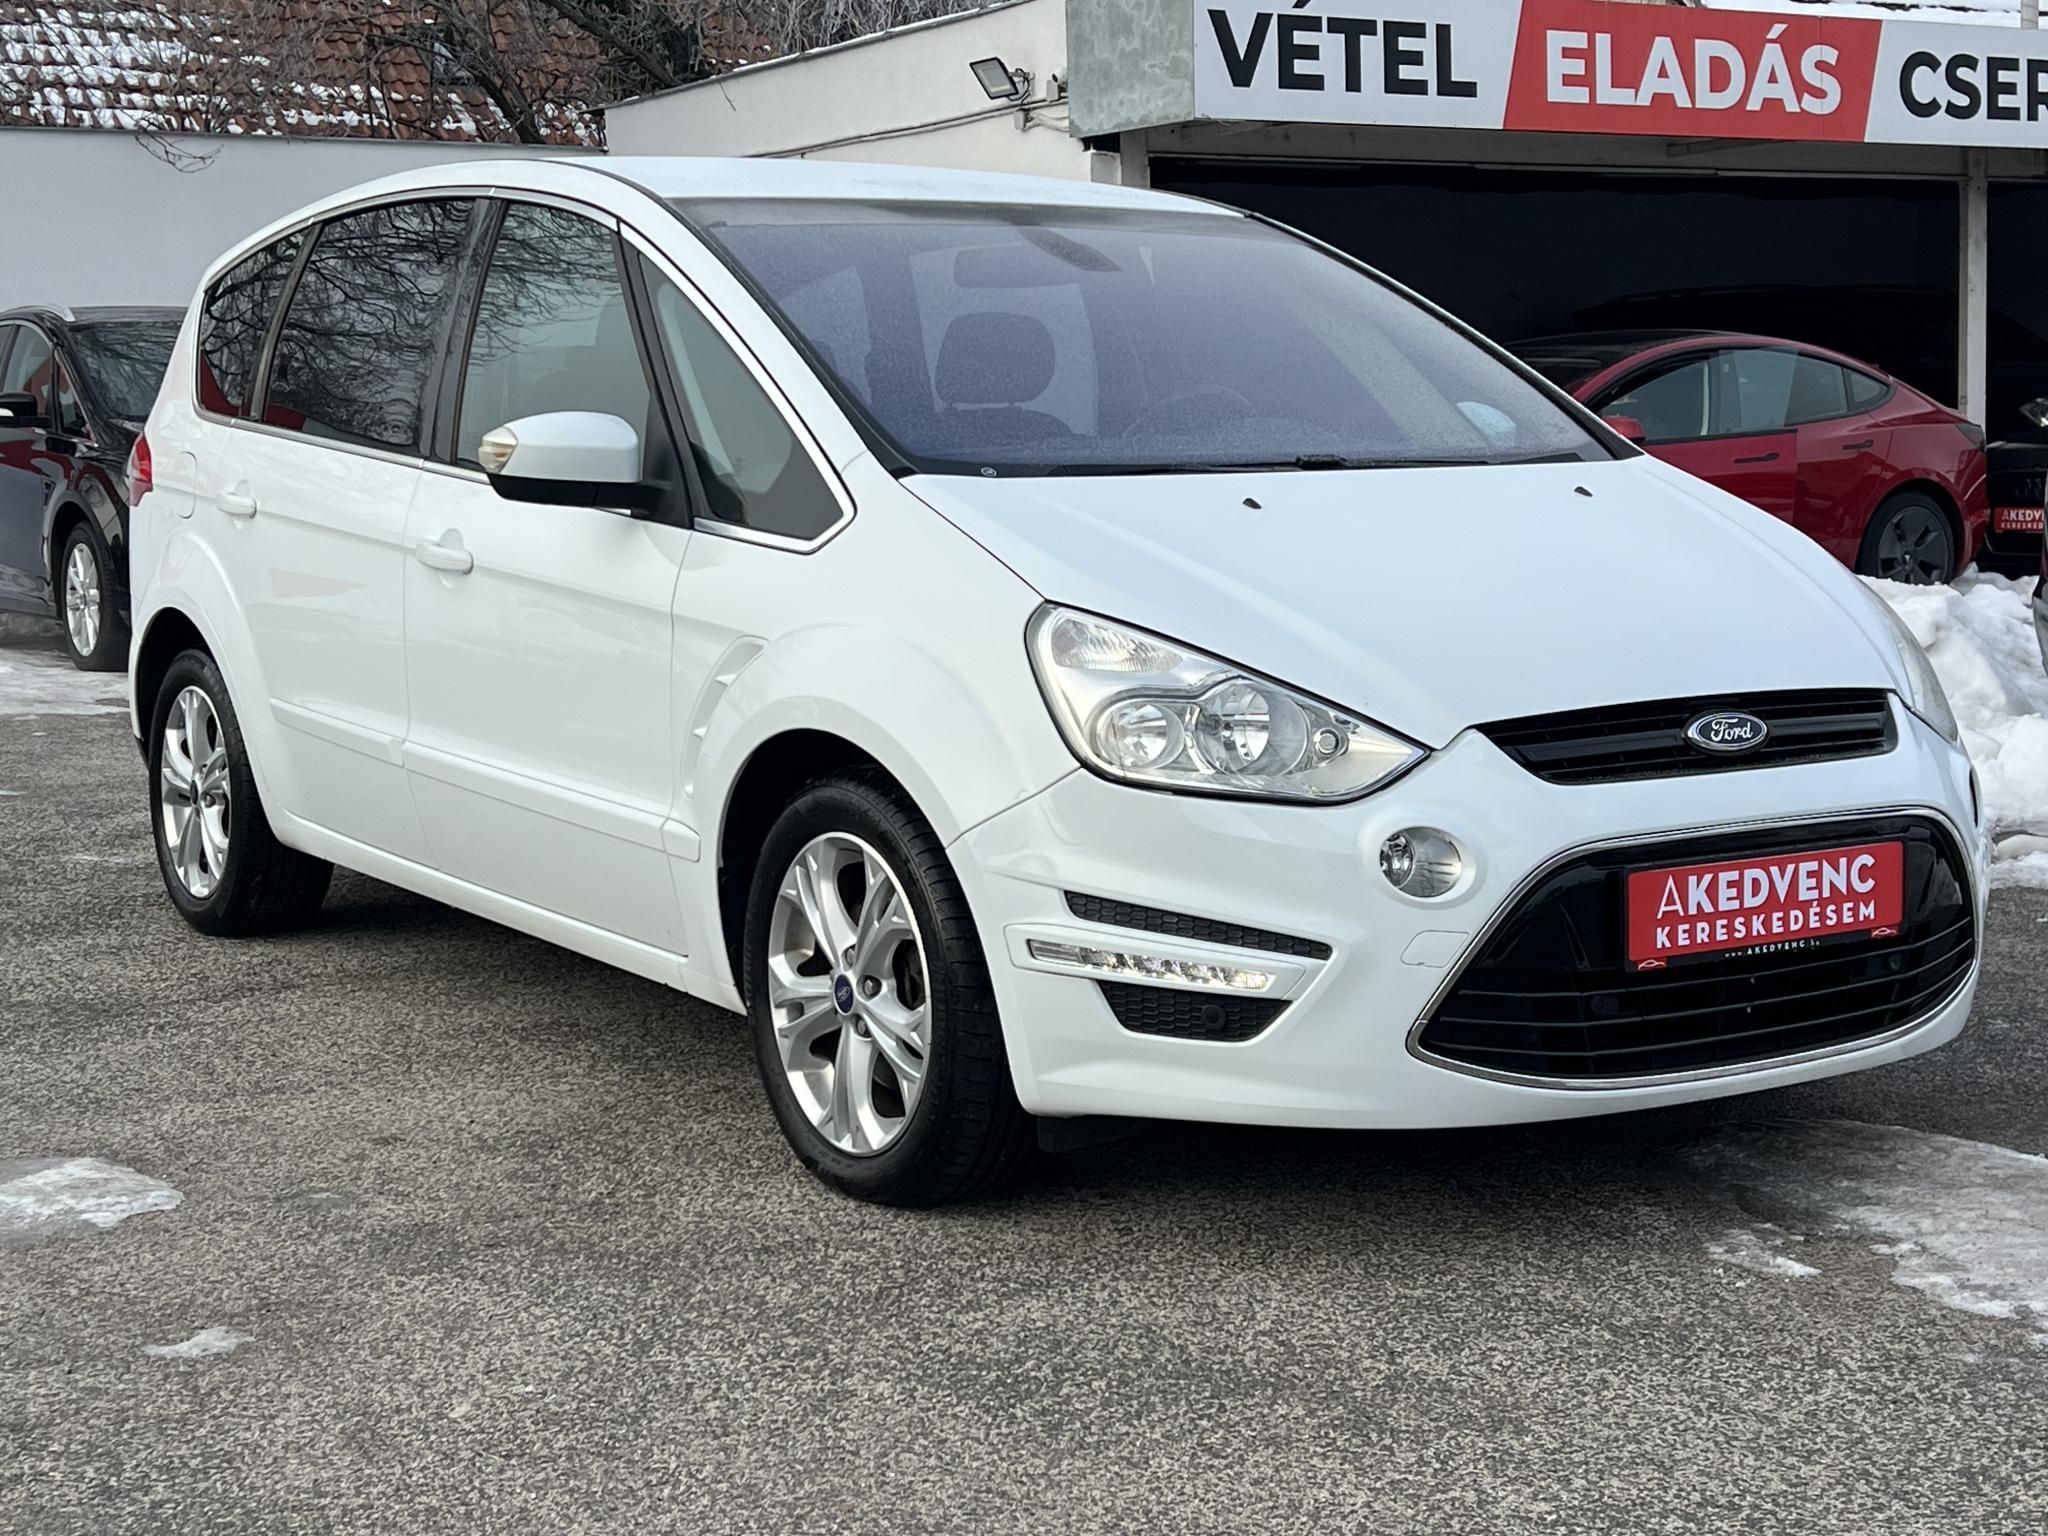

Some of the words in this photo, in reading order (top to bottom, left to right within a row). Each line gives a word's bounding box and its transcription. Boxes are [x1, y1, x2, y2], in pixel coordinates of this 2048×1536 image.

[1207, 0, 1478, 98] VÉTEL
[1546, 23, 1842, 115] ELADÁS
[1900, 51, 2048, 121] CSER
[1711, 718, 1753, 741] Ford
[1656, 854, 1876, 919] AKEDVENC
[1656, 900, 1876, 949] KERESKEDÉSEM
